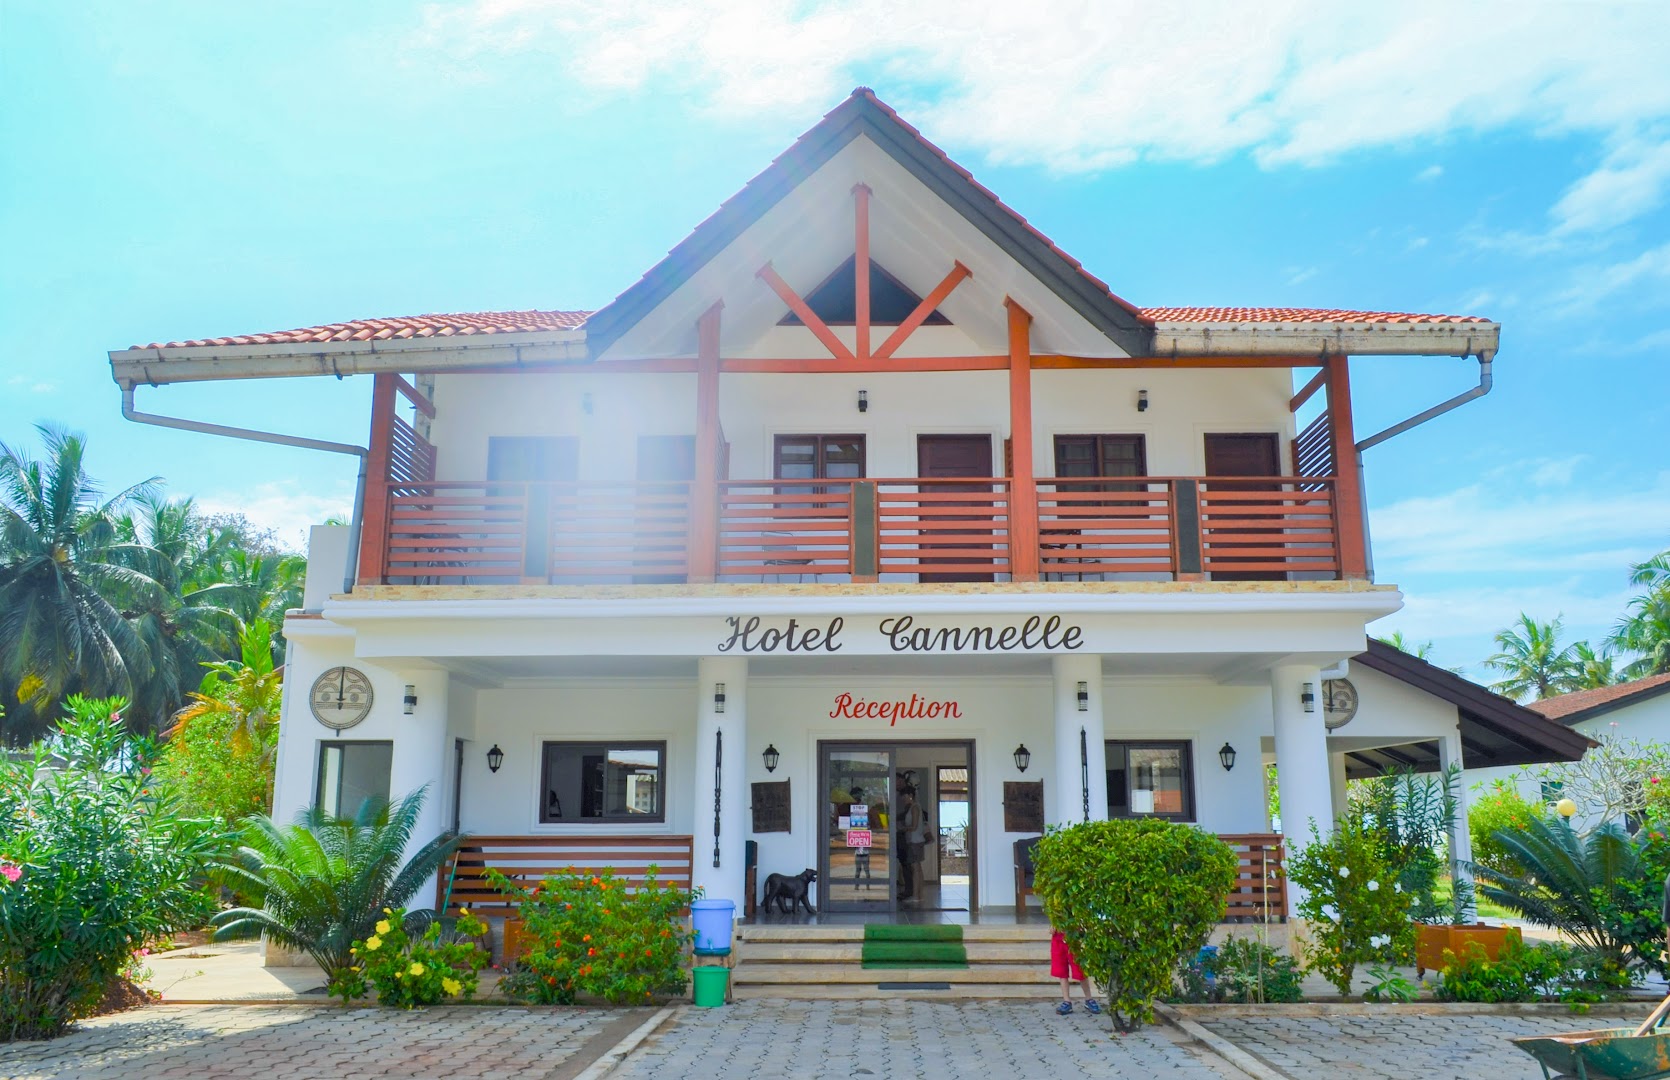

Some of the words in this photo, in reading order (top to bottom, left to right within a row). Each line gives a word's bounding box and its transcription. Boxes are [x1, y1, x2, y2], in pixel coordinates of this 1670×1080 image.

[717, 616, 844, 652] Hotel
[879, 615, 1084, 651] Cannelle
[829, 692, 962, 726] Réception
[849, 837, 869, 846] OPEN
